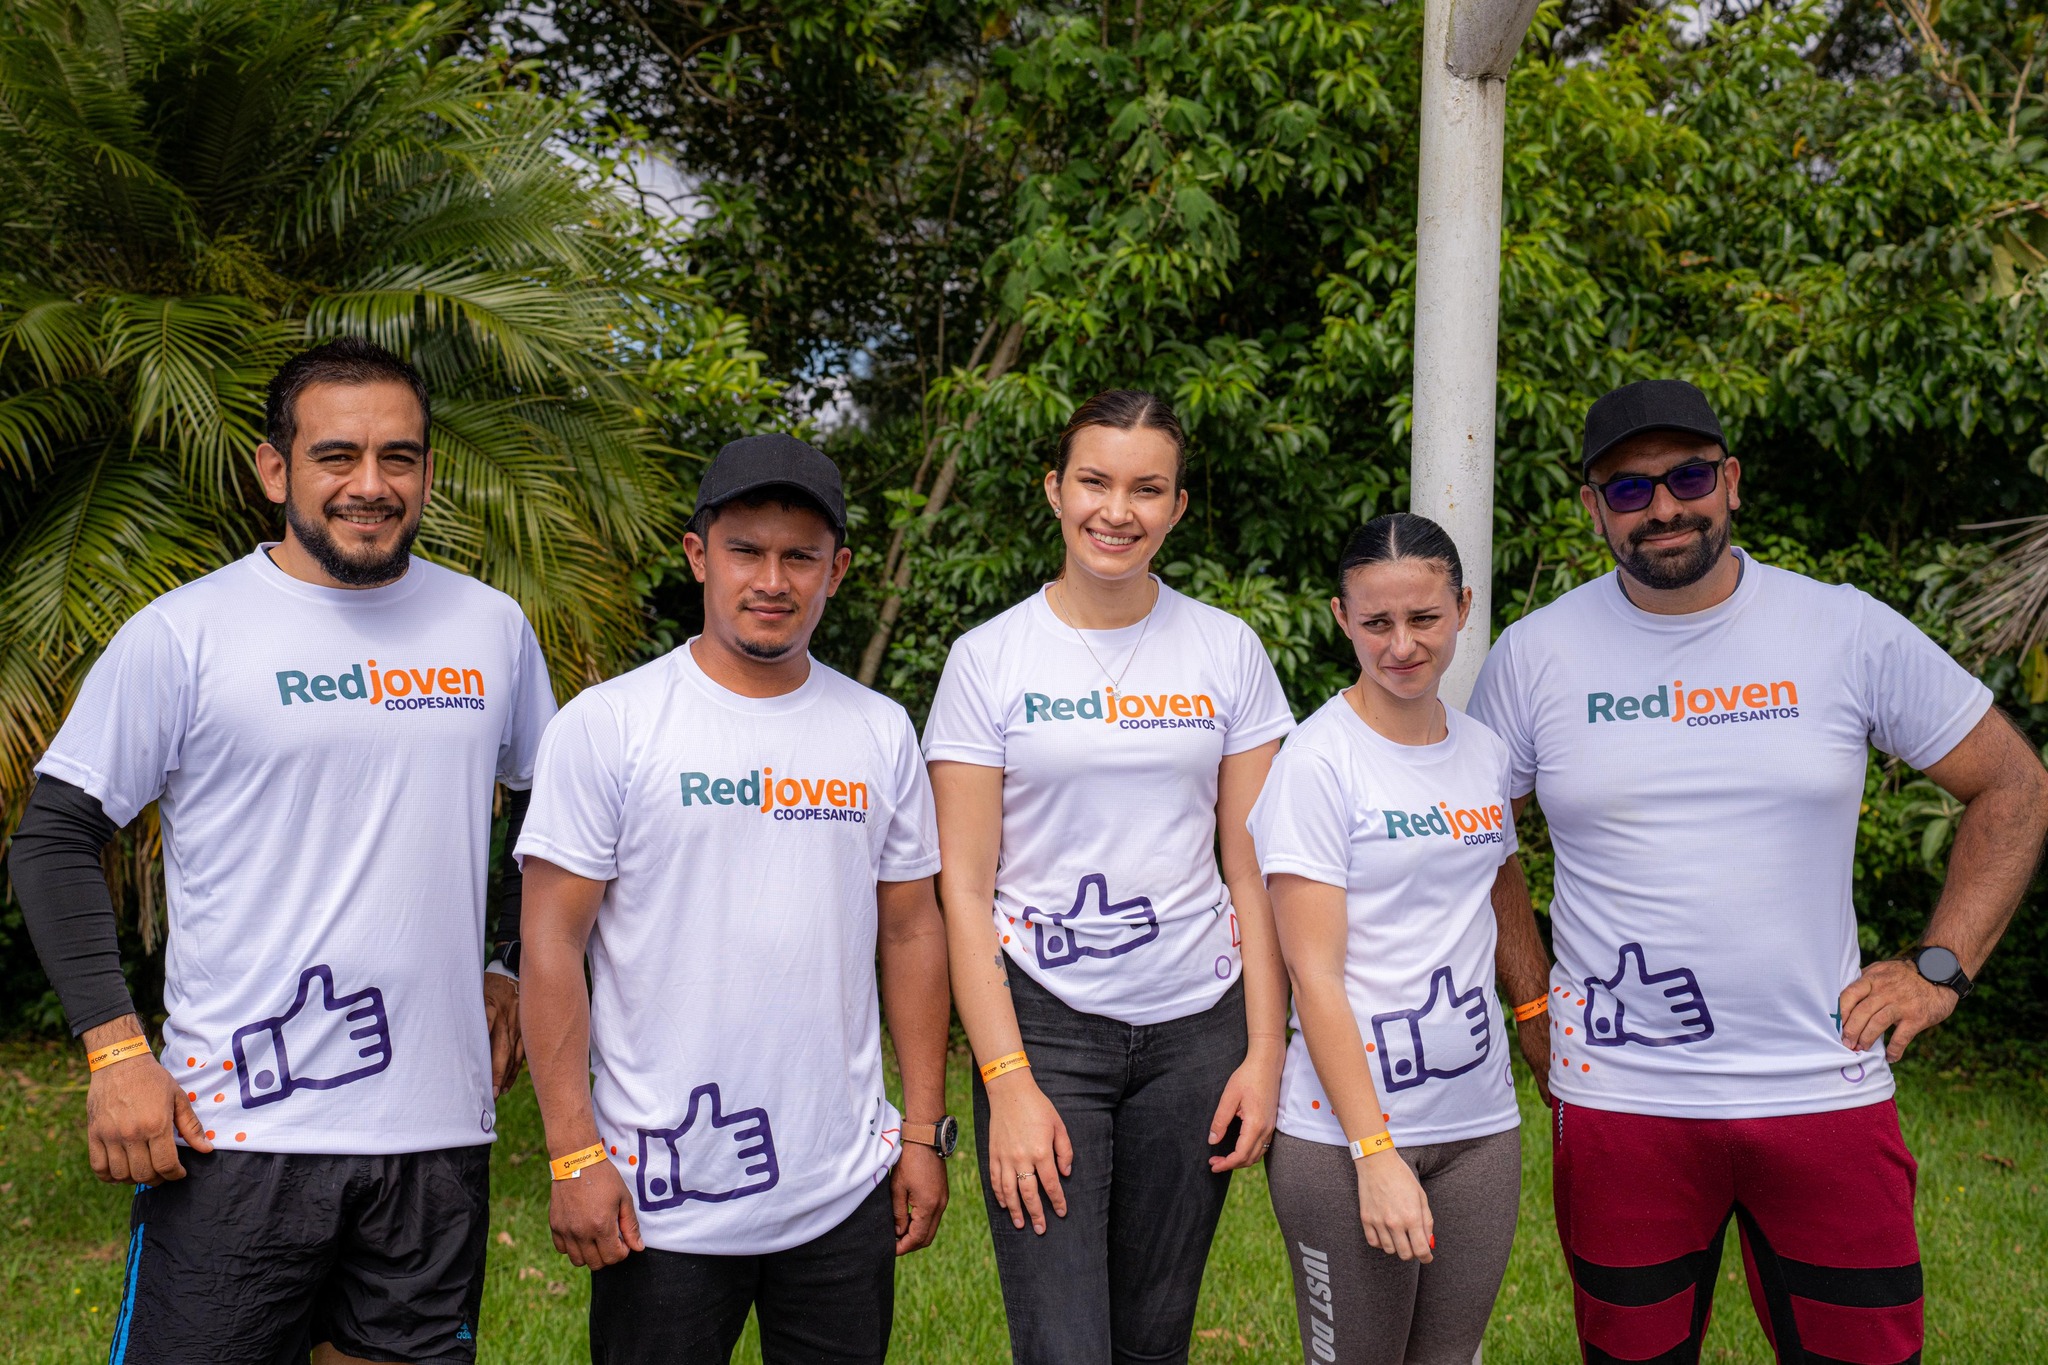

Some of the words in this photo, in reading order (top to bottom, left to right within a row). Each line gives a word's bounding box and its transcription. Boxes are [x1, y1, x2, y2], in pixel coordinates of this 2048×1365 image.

[385, 697, 485, 711] COOPESANTOS
[1119, 718, 1215, 731] COOPESANTOS
[1686, 707, 1800, 727] COOPESANTOS
[773, 808, 866, 823] COOPESANTOS
[1382, 801, 1504, 840] Redjove
[1297, 1241, 1334, 1321] JUST
[1311, 1315, 1336, 1362] DO
